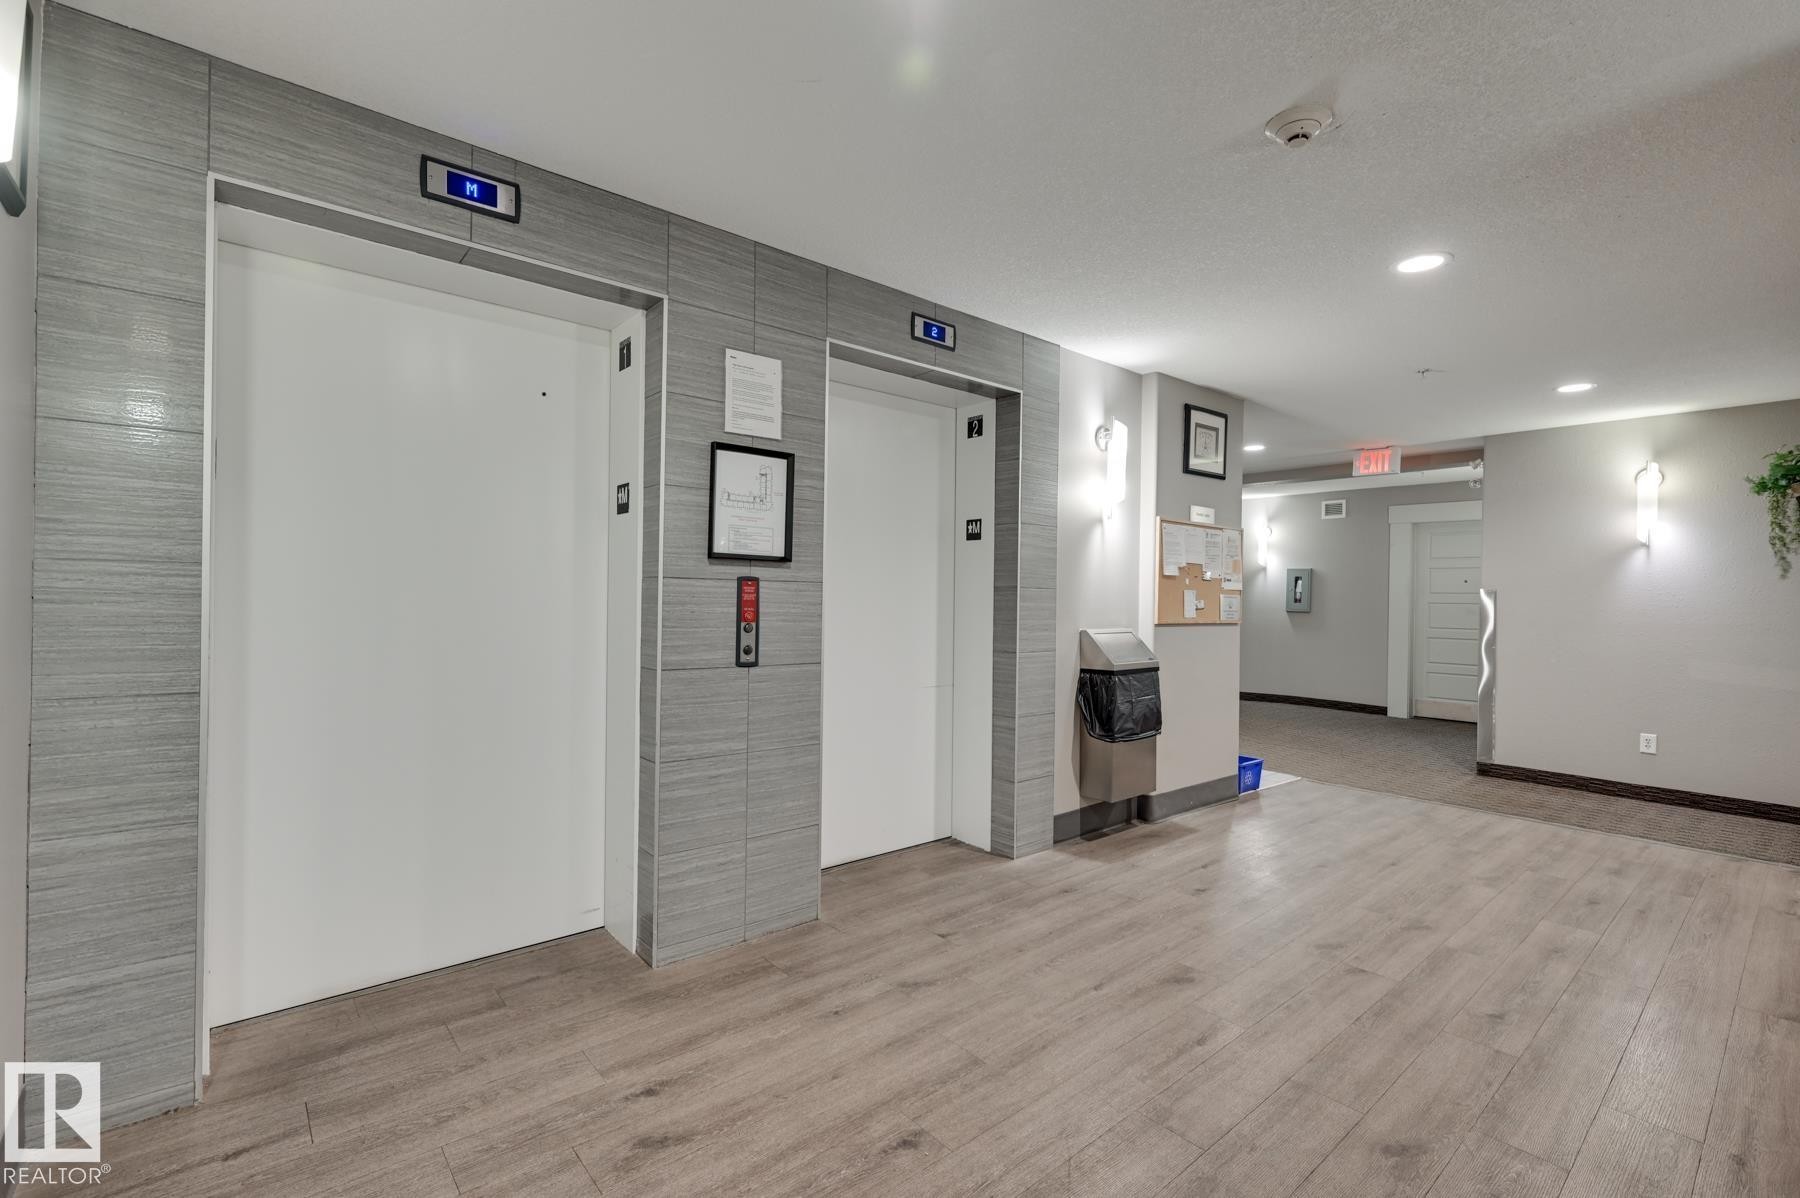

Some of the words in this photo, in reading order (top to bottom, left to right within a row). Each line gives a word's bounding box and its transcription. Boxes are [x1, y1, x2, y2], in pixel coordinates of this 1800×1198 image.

[466, 181, 478, 198] M
[931, 326, 938, 337] 2
[972, 420, 979, 437] 2
[1360, 449, 1390, 474] EXIT
[972, 521, 980, 534] M
